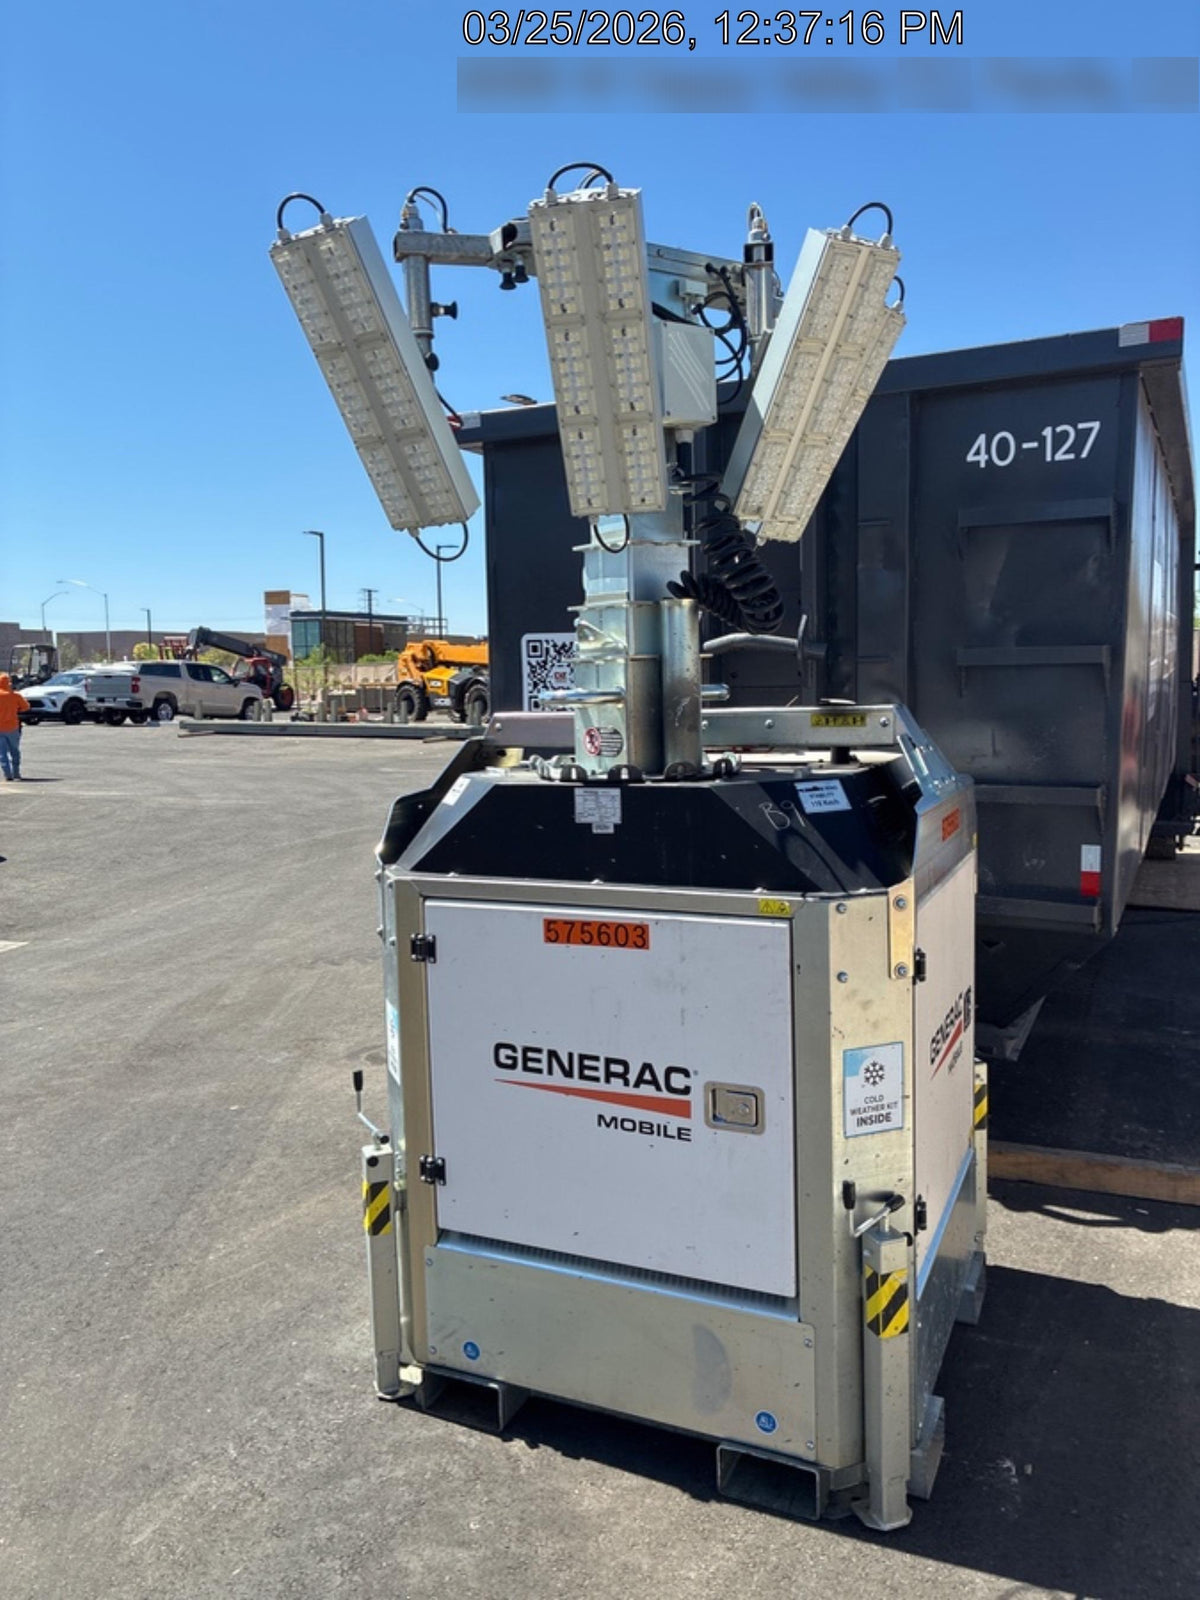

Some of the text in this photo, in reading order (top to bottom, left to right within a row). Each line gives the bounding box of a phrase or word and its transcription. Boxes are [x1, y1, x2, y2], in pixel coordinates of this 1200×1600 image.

[966, 421, 1101, 468] 40-127
[545, 920, 648, 949] 575603
[493, 1042, 693, 1096] GENERAC
[850, 1100, 899, 1116] WEATHER KIT
[863, 1094, 885, 1105] COLD
[596, 1113, 693, 1142] MOBILE
[856, 1112, 892, 1128] INSIDE
